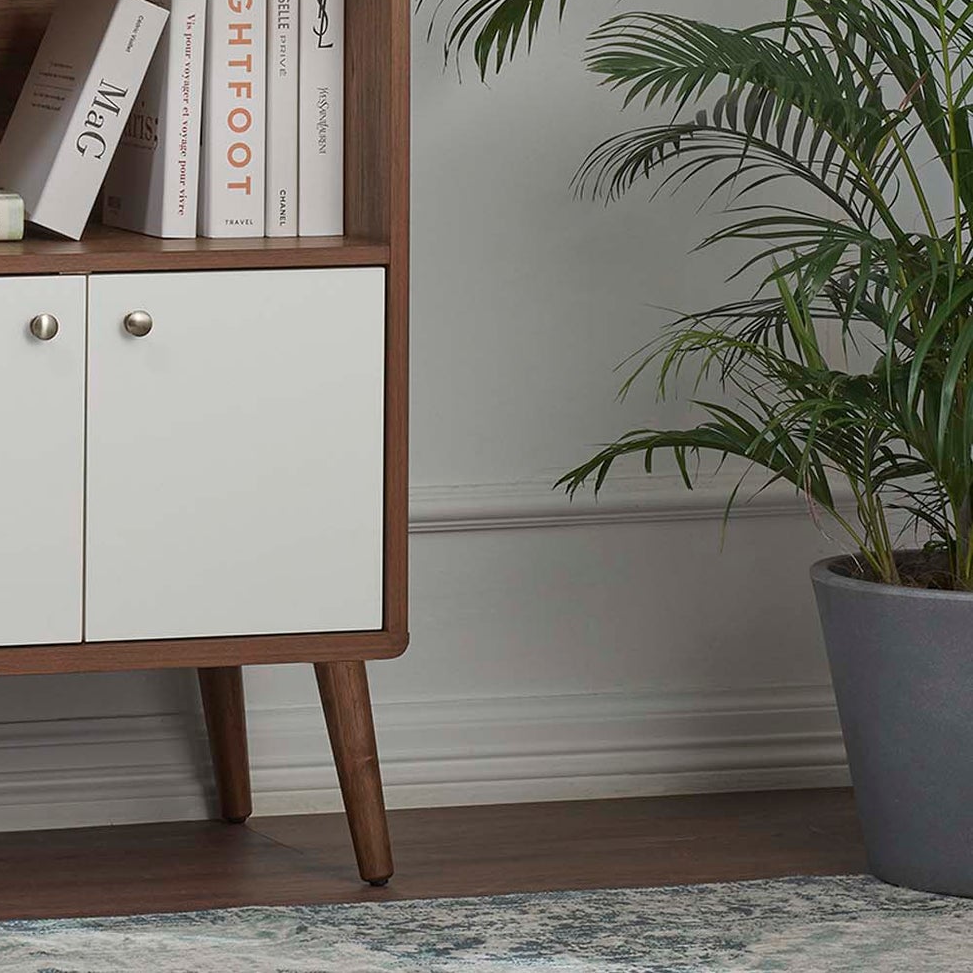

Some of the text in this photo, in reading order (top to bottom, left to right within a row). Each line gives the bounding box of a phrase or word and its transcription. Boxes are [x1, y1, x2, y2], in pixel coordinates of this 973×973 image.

[76, 78, 129, 160] MaG
[178, 14, 195, 216] Vis pour voyager et voyage pour vivre
[279, 189, 287, 227] CHANEL
